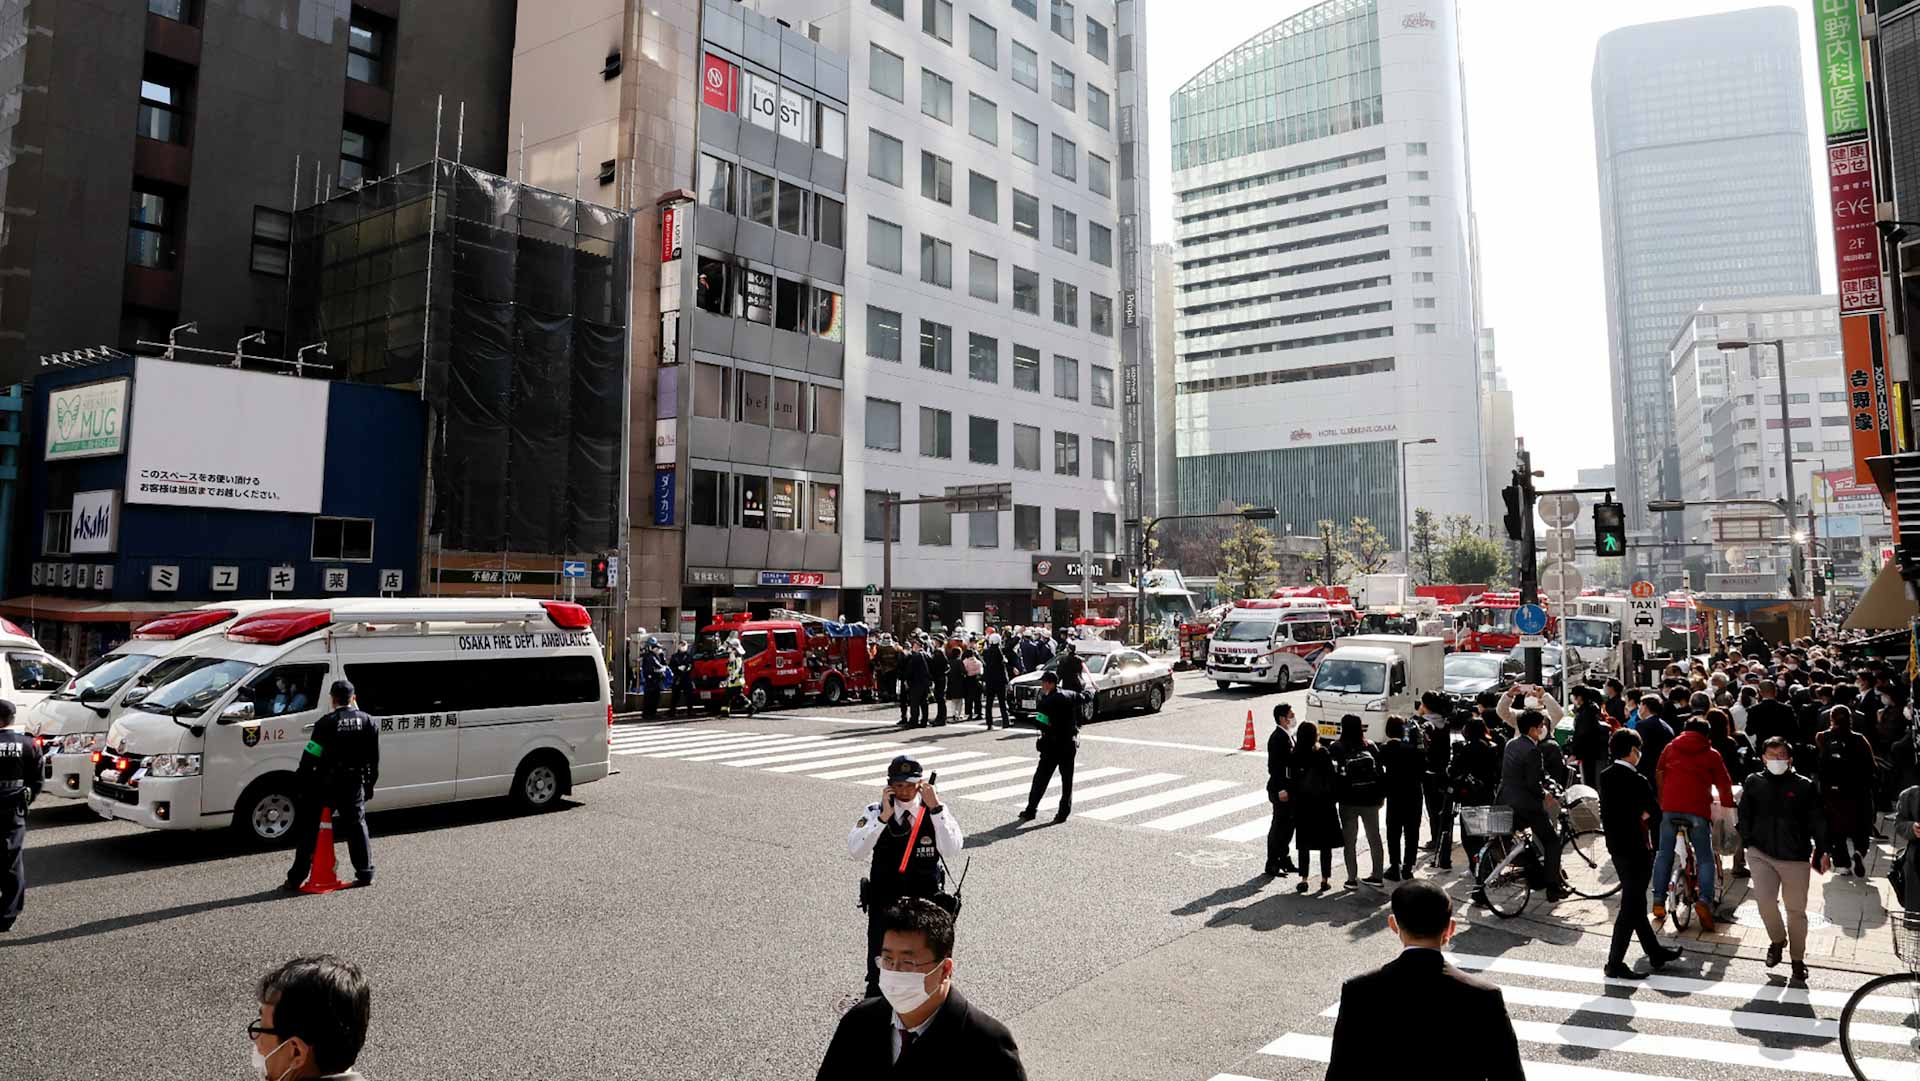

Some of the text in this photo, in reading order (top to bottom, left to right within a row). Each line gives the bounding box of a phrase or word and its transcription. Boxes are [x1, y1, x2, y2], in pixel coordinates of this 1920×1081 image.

[1823, 0, 1860, 133] 中野内科医院
[752, 92, 800, 127] LOST
[1832, 145, 1865, 159] 健康
[1834, 160, 1865, 174] やせ
[1835, 197, 1872, 218] EVE
[1848, 237, 1866, 250] 2F
[1843, 277, 1878, 292] 健康
[1845, 293, 1878, 307] やせ
[1850, 369, 1874, 431] 吉野家
[1874, 366, 1889, 431] YOSHINOYA
[80, 407, 117, 438] MUG
[1318, 429, 1338, 437] HOTEL
[140, 470, 260, 486] このスペースをお使い頂ける
[140, 483, 280, 500] お客様は当店までお越しください。
[73, 503, 110, 542] Asahi
[157, 568, 399, 588] ミユキ薬店
[472, 570, 522, 583] 不動産.COM
[793, 574, 822, 585] ダンカン
[1630, 601, 1657, 609] TAXI
[459, 632, 590, 651] OSAKA FIRE DEPT. AMBULANCE
[1109, 683, 1148, 699] POLICE
[264, 729, 285, 741] A 12
